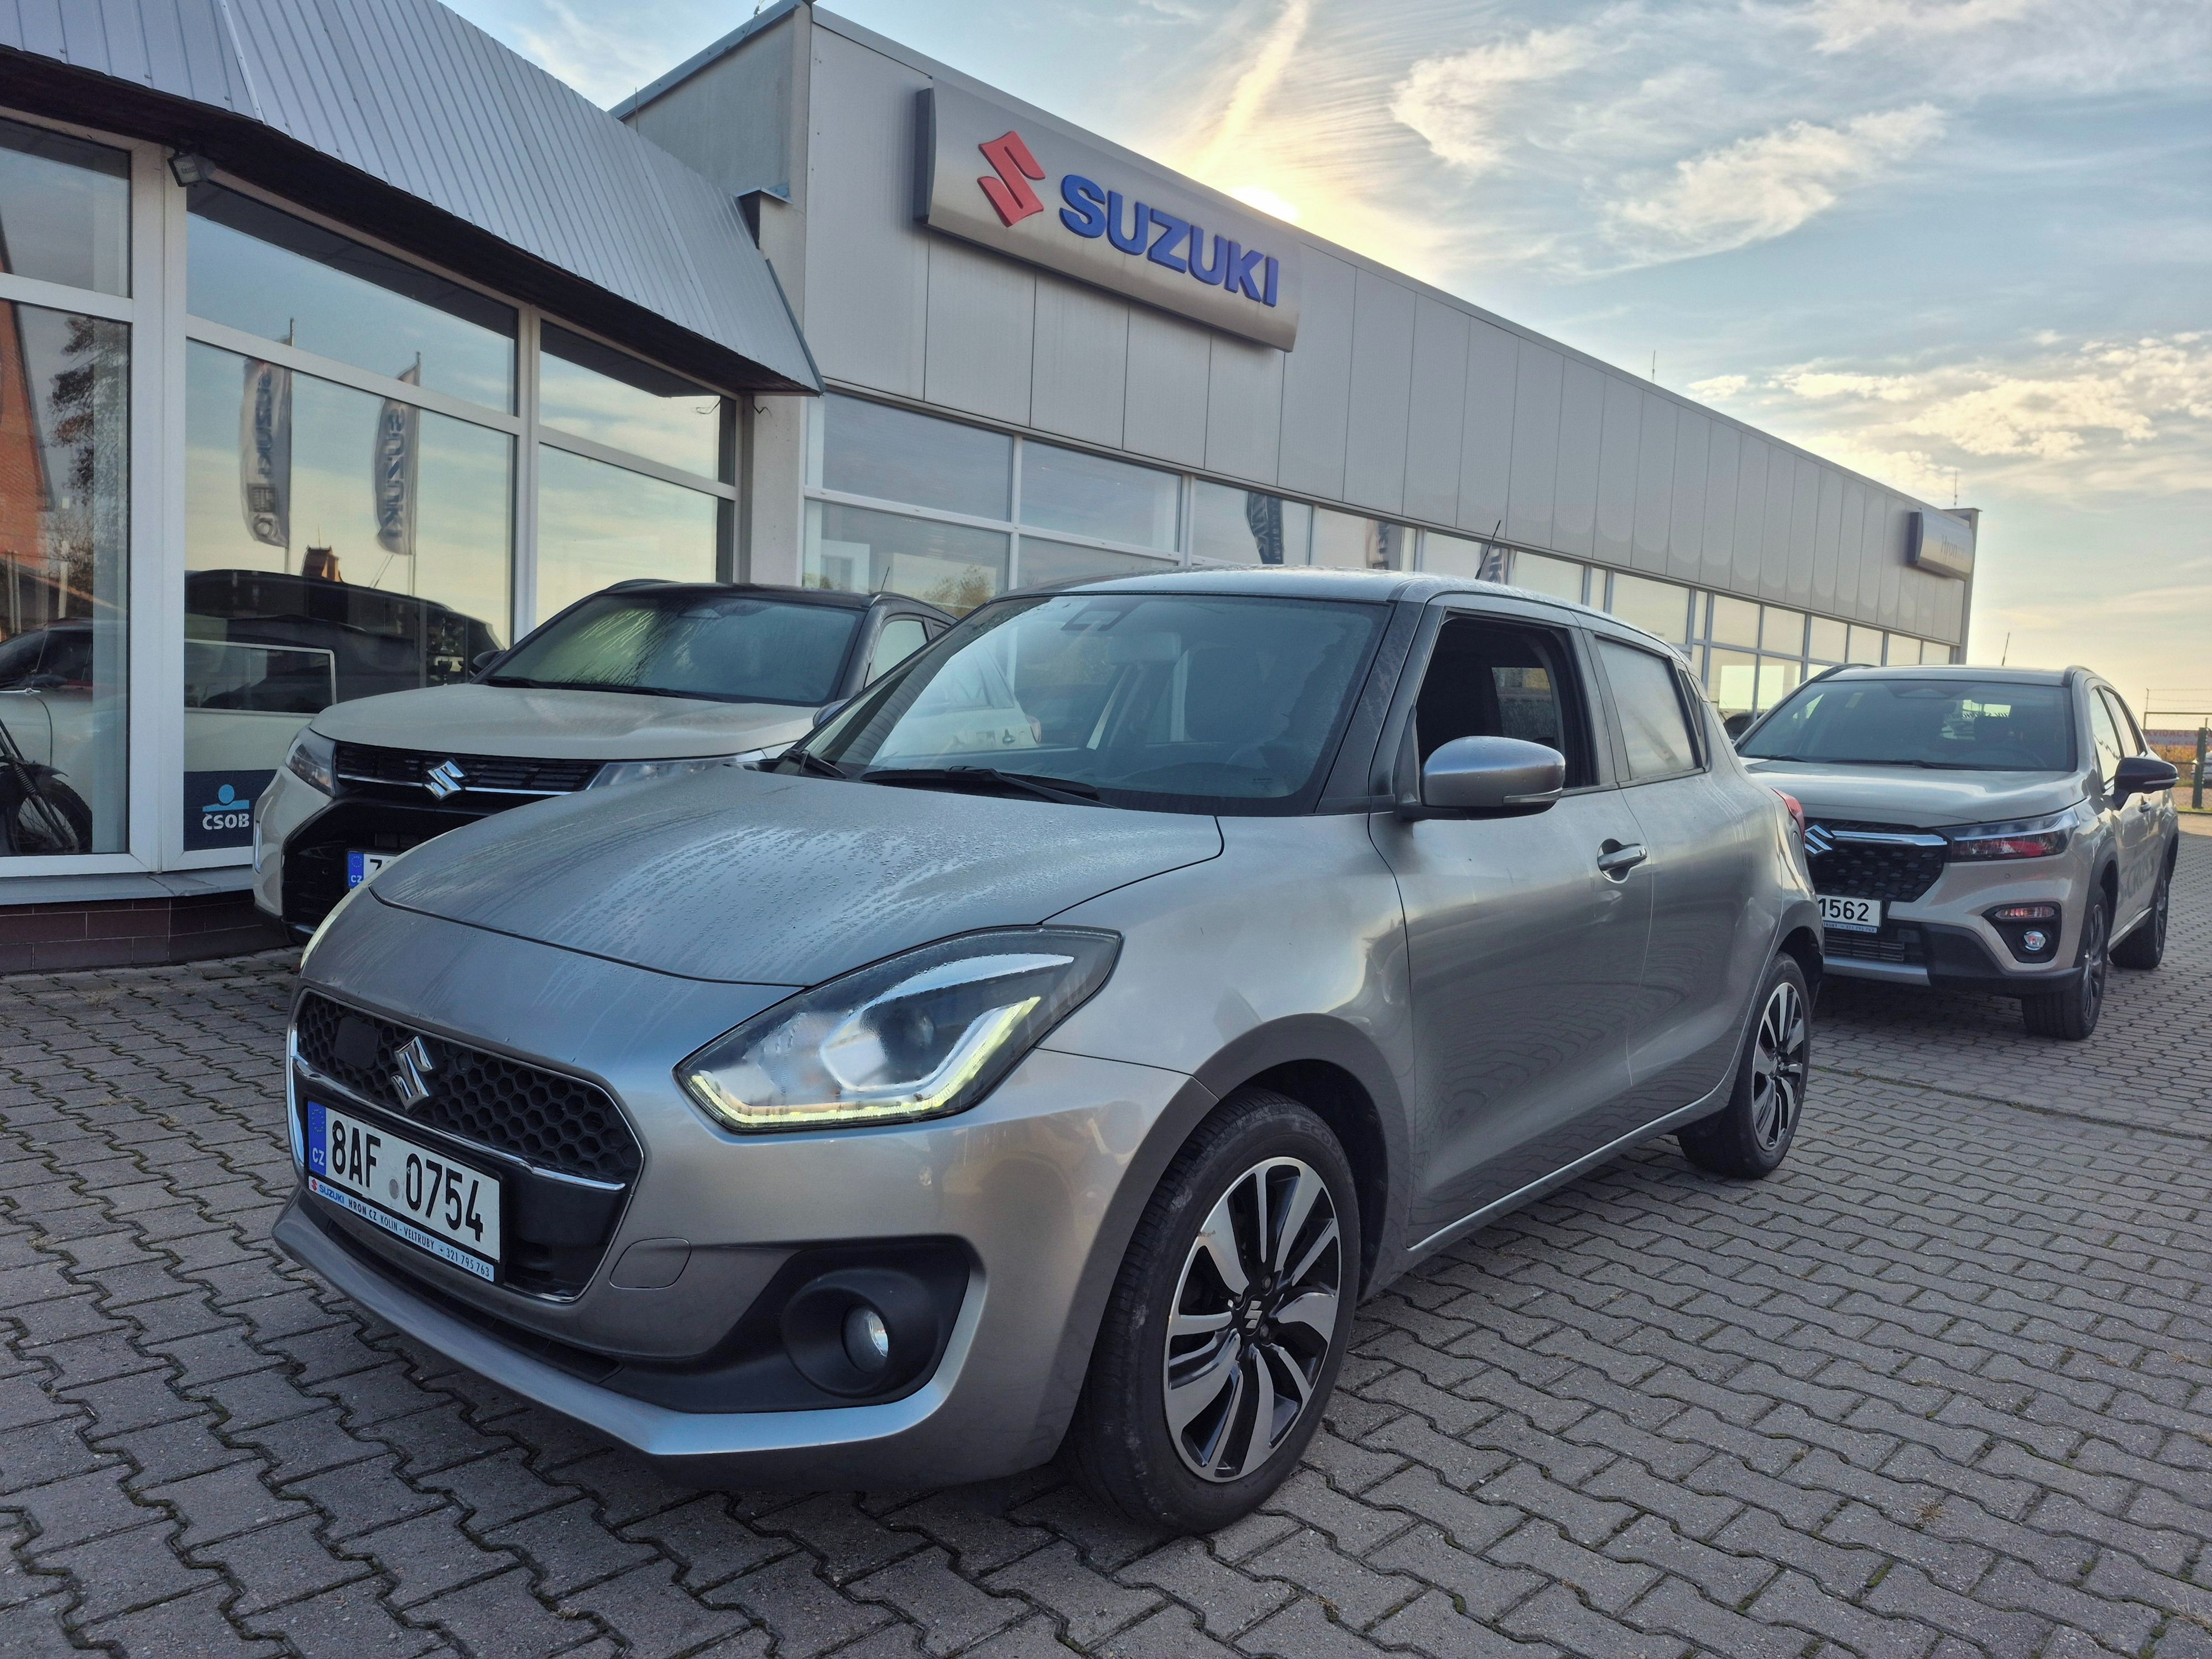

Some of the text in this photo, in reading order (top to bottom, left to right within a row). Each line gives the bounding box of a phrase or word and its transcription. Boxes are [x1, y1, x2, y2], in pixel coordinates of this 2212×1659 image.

[1059, 174, 1279, 307] SUZUKI
[1940, 534, 1958, 557] Hron
[202, 813, 249, 830] ČSOB
[351, 875, 363, 884] CZ
[1818, 898, 1869, 922] 1562
[312, 1147, 325, 1167] CZ
[332, 1120, 483, 1243] 8AF 0754
[319, 1184, 345, 1204] SUZUKI
[348, 1199, 367, 1215] HRON
[369, 1209, 377, 1220] CZ
[380, 1214, 398, 1232] KOLÍN
[404, 1227, 434, 1250] VELTRUBY
[446, 1248, 458, 1261] 321
[461, 1255, 474, 1269] 795
[477, 1262, 489, 1277] 763
